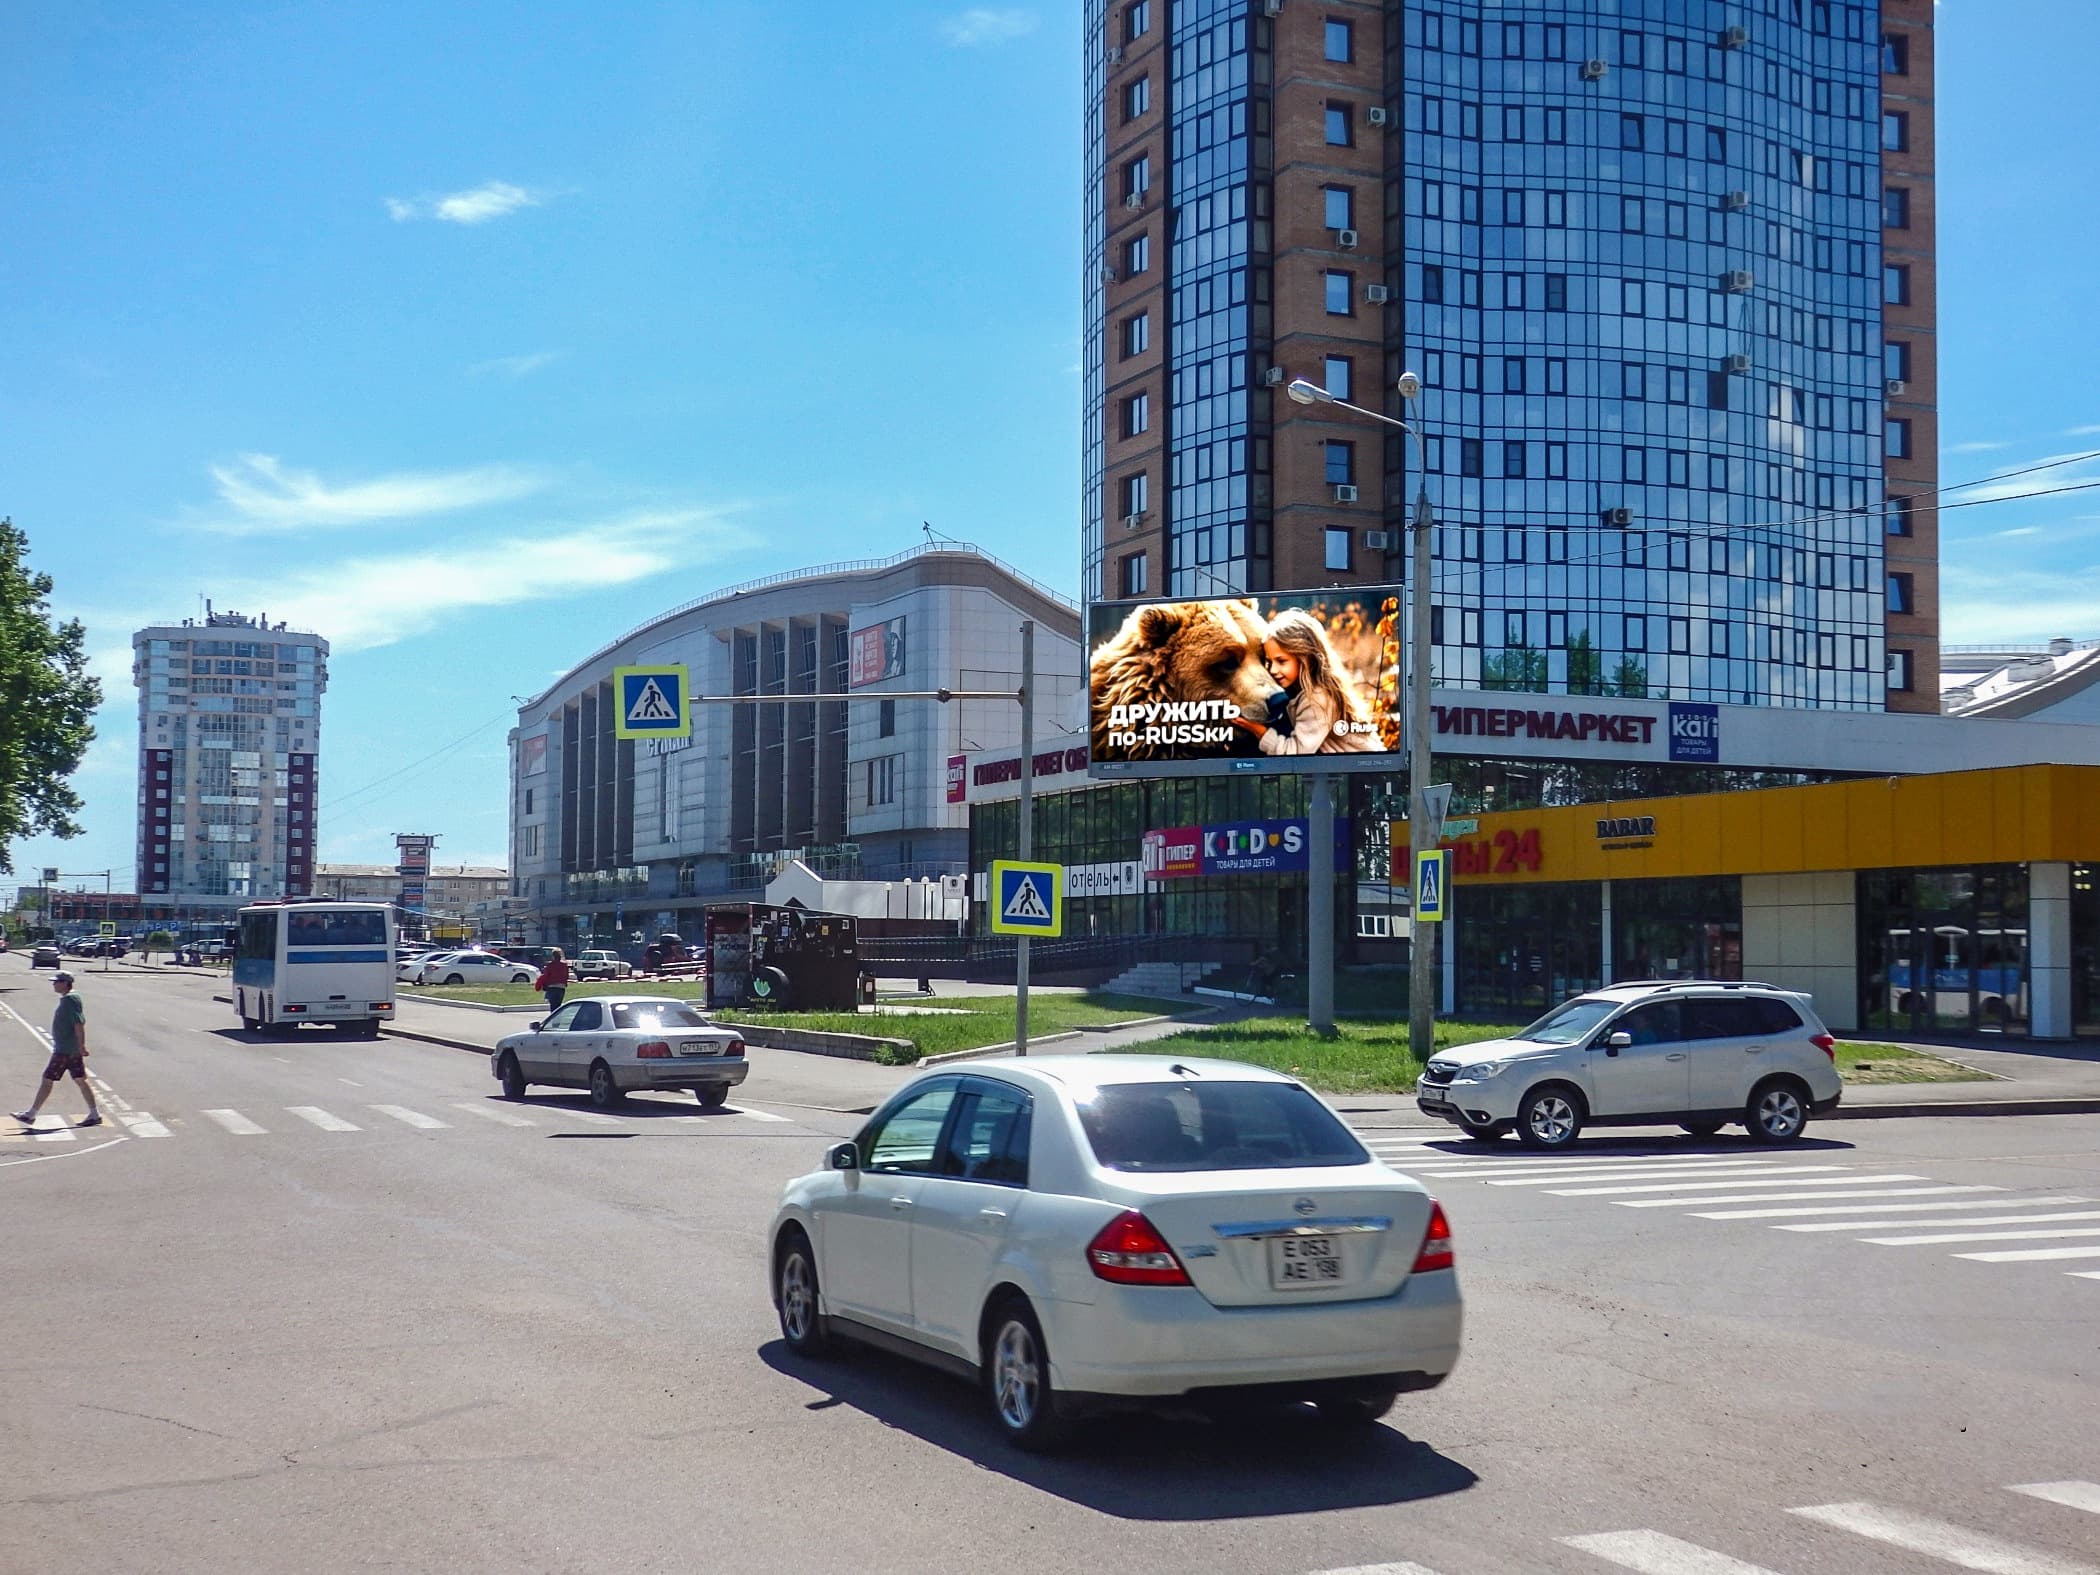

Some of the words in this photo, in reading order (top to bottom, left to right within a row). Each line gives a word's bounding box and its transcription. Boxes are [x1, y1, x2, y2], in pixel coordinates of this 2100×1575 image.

[1107, 699, 1241, 728] ДРУЖИТЬ
[1108, 722, 1234, 747] по-RUSSки
[1672, 714, 1719, 738] kari
[1166, 845, 1197, 861] ГИПЕР
[1494, 829, 1541, 873] 24
[1071, 872, 1109, 888] отель
